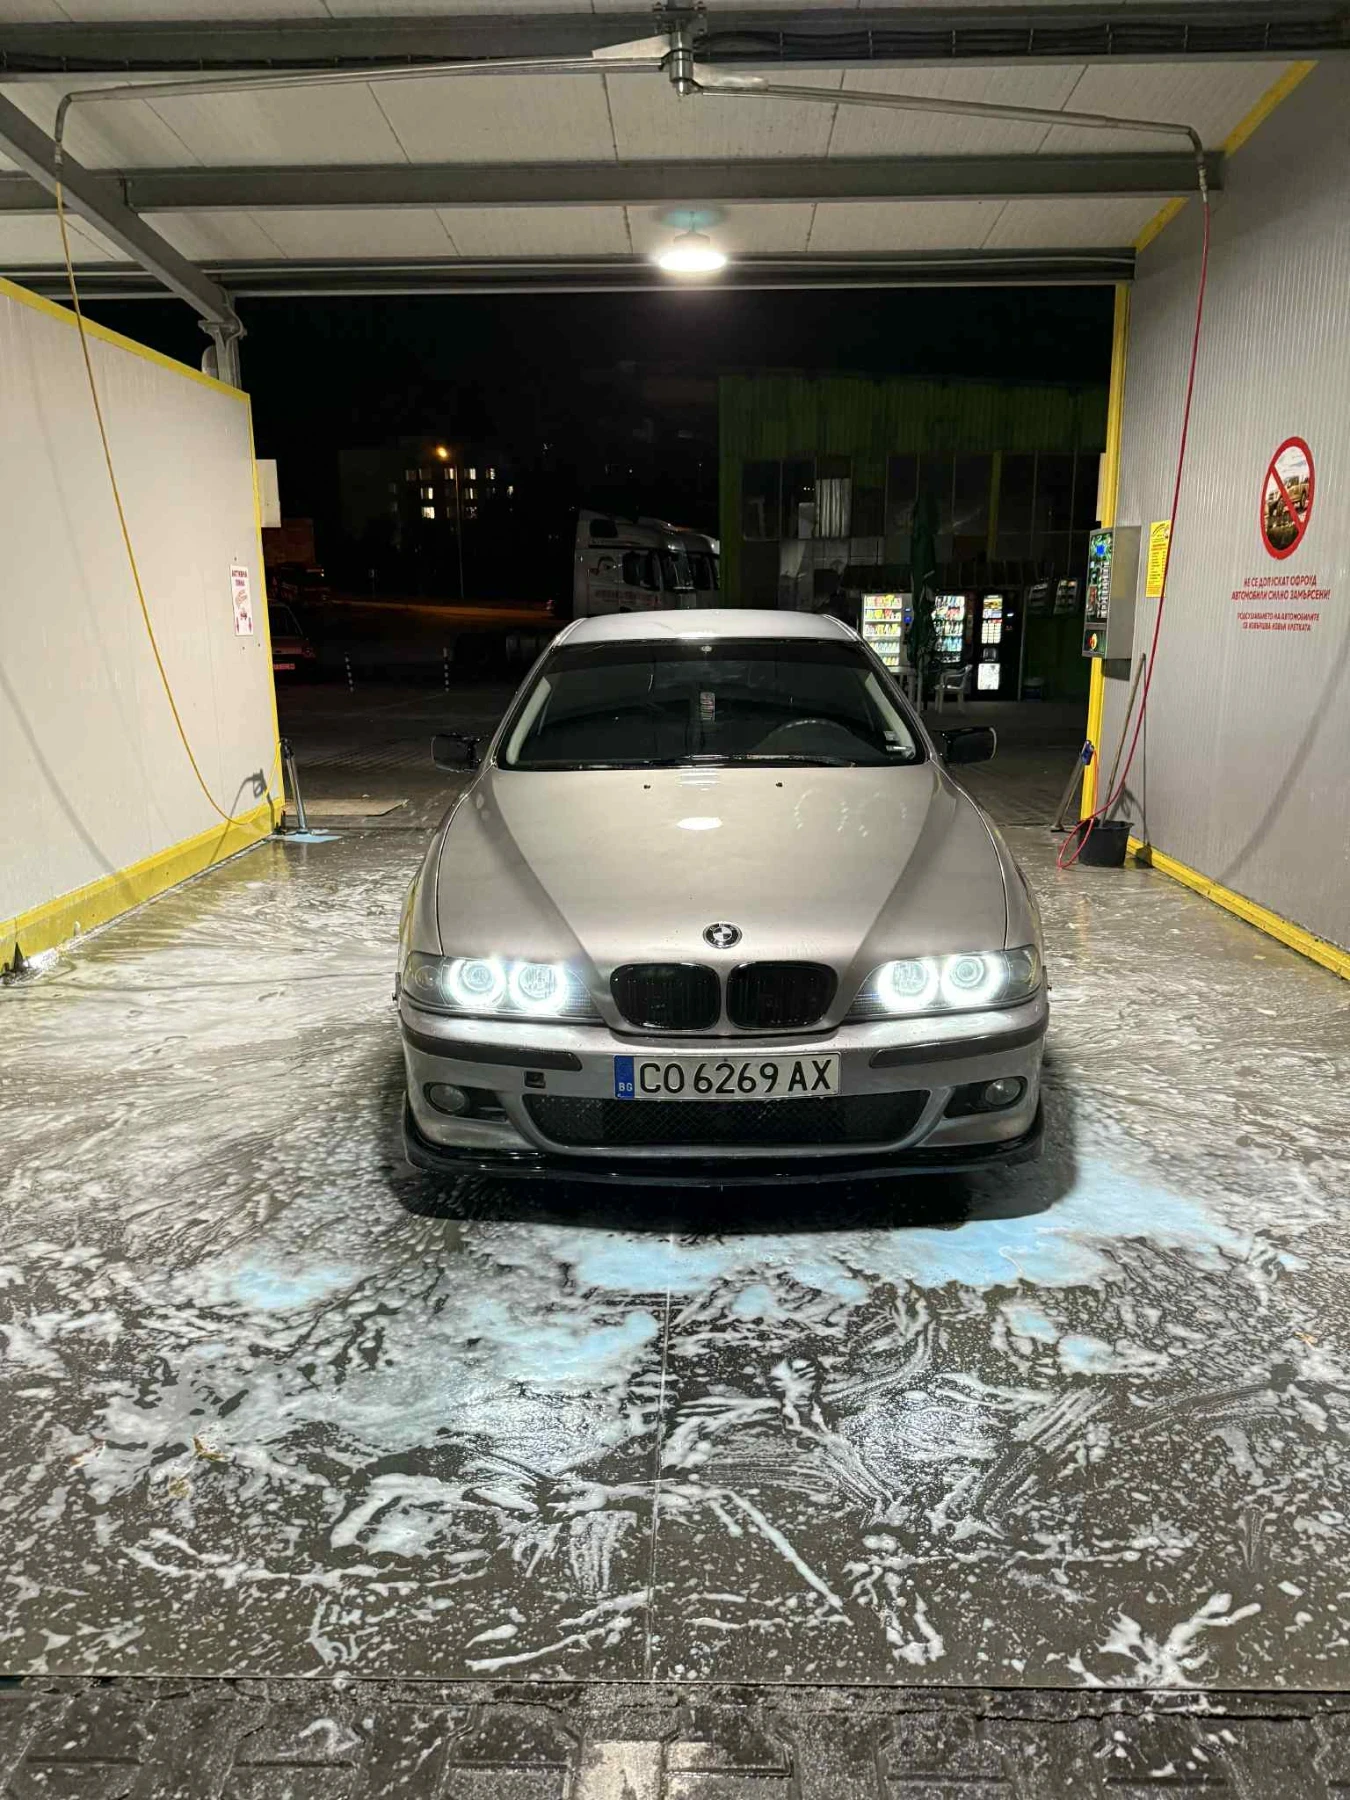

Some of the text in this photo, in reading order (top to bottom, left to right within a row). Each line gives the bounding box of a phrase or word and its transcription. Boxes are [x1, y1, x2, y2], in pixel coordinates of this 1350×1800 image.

[1251, 577, 1258, 587] СЕ
[1259, 575, 1289, 588] ДОПУСКАТ
[1291, 574, 1317, 587] ОФРОУД
[1231, 590, 1267, 600] АВТОМОБИЛИ
[1268, 590, 1289, 600] СИЛНО
[693, 1062, 779, 1094] 6269
[618, 1082, 633, 1092] BG
